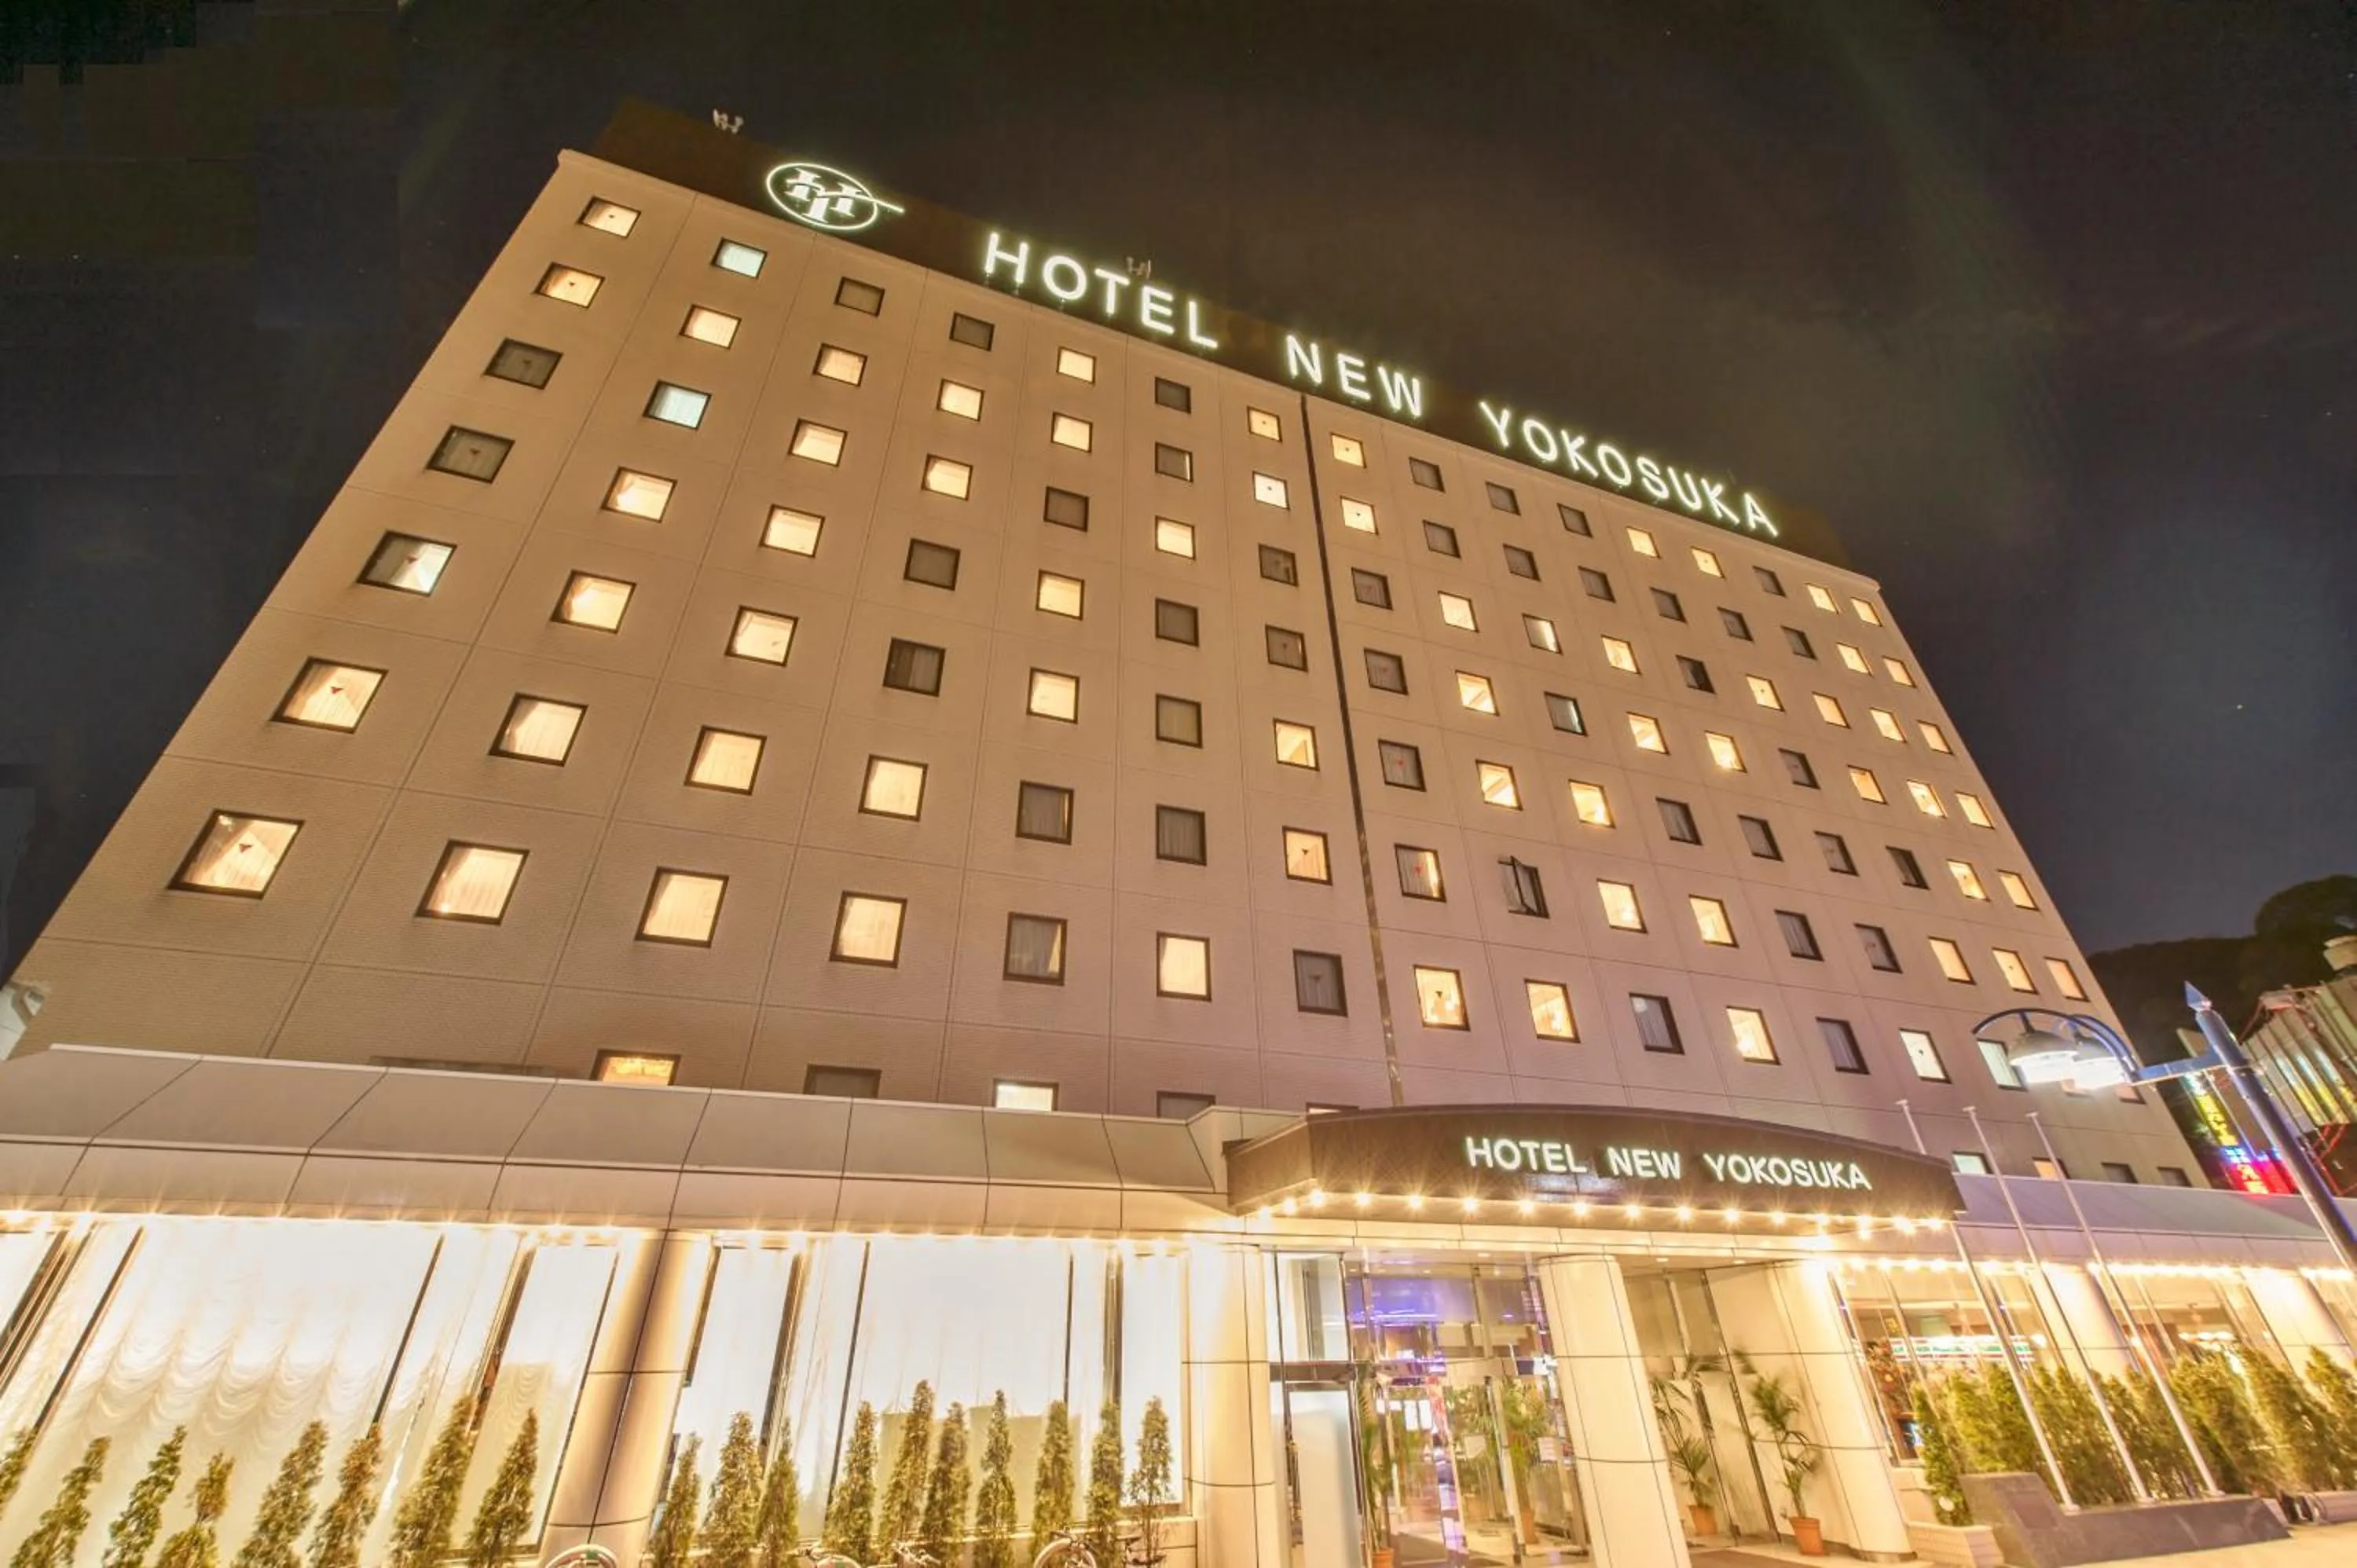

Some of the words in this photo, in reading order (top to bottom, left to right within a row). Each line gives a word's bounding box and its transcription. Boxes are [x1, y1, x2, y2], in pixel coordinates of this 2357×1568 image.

[984, 232, 1218, 349] HOTEL
[1287, 334, 1421, 417] NEW
[1480, 401, 1780, 537] YOKOSUKA
[1466, 1138, 1587, 1174] HOTEL
[1607, 1147, 1682, 1180] NEW
[1703, 1153, 1873, 1190] YOKOSUKA
